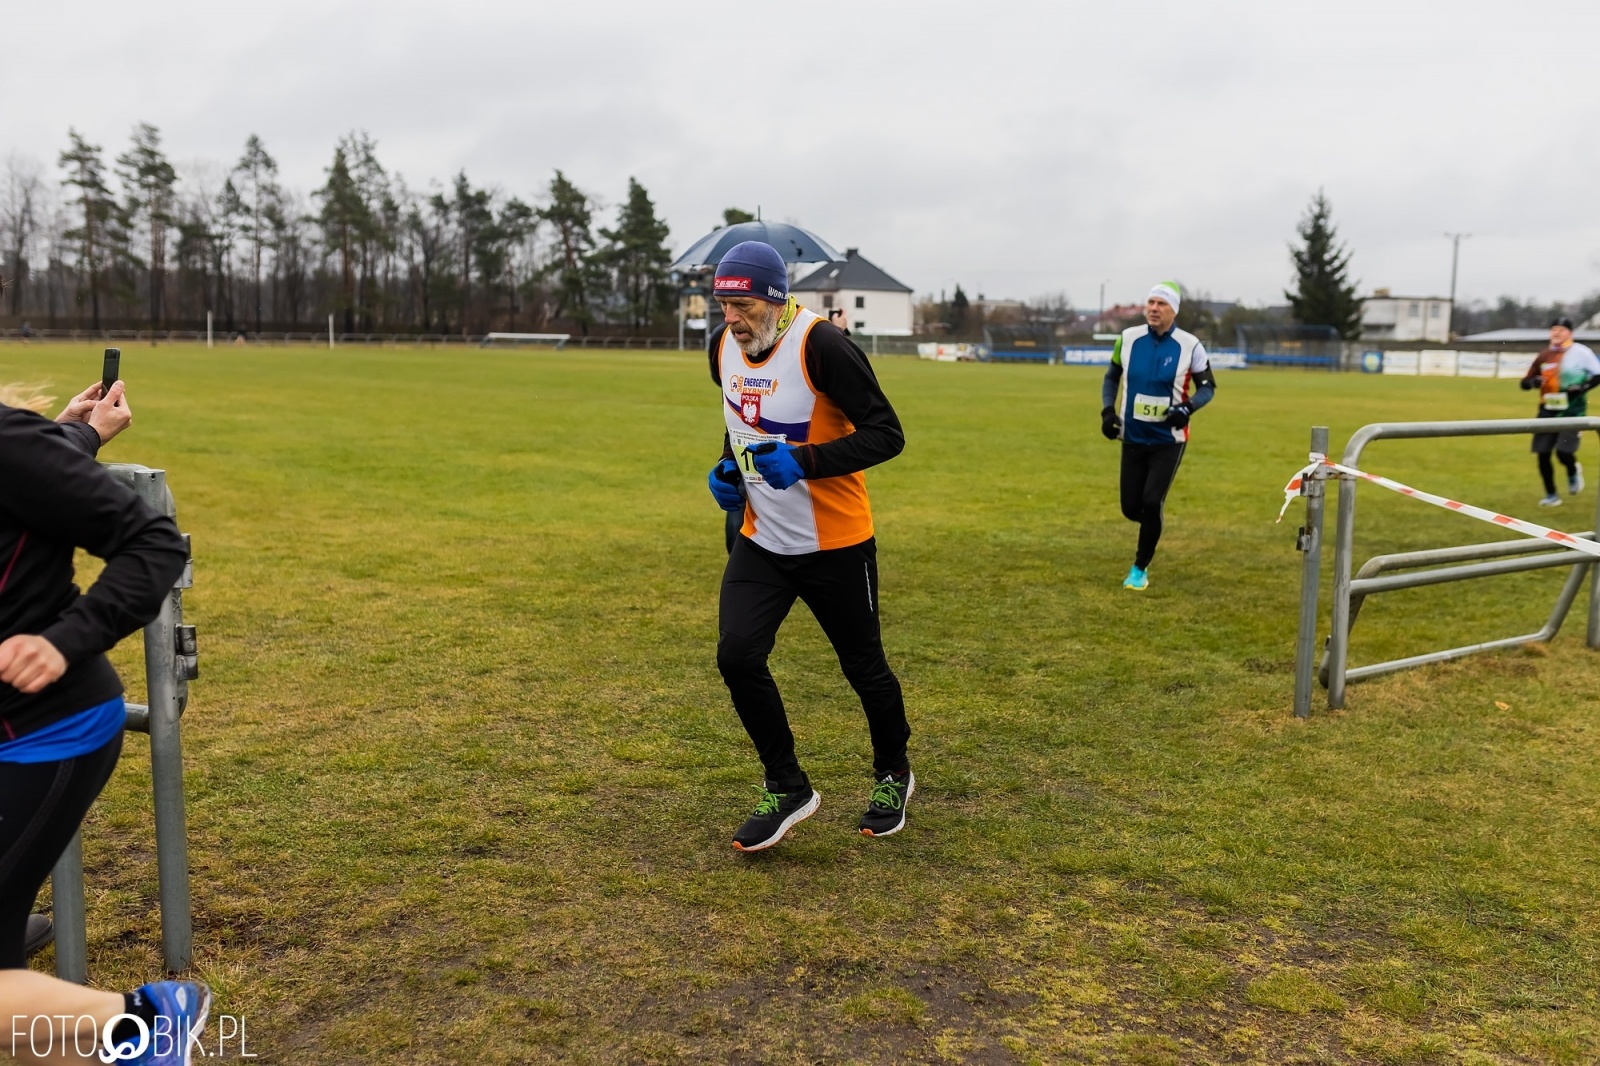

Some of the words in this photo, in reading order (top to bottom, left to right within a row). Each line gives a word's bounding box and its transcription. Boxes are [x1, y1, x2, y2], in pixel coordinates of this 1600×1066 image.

[744, 377, 772, 389] ENERGETYK
[743, 387, 770, 396] RYBNIK
[741, 394, 759, 402] POLSKA
[1143, 404, 1158, 416] 51
